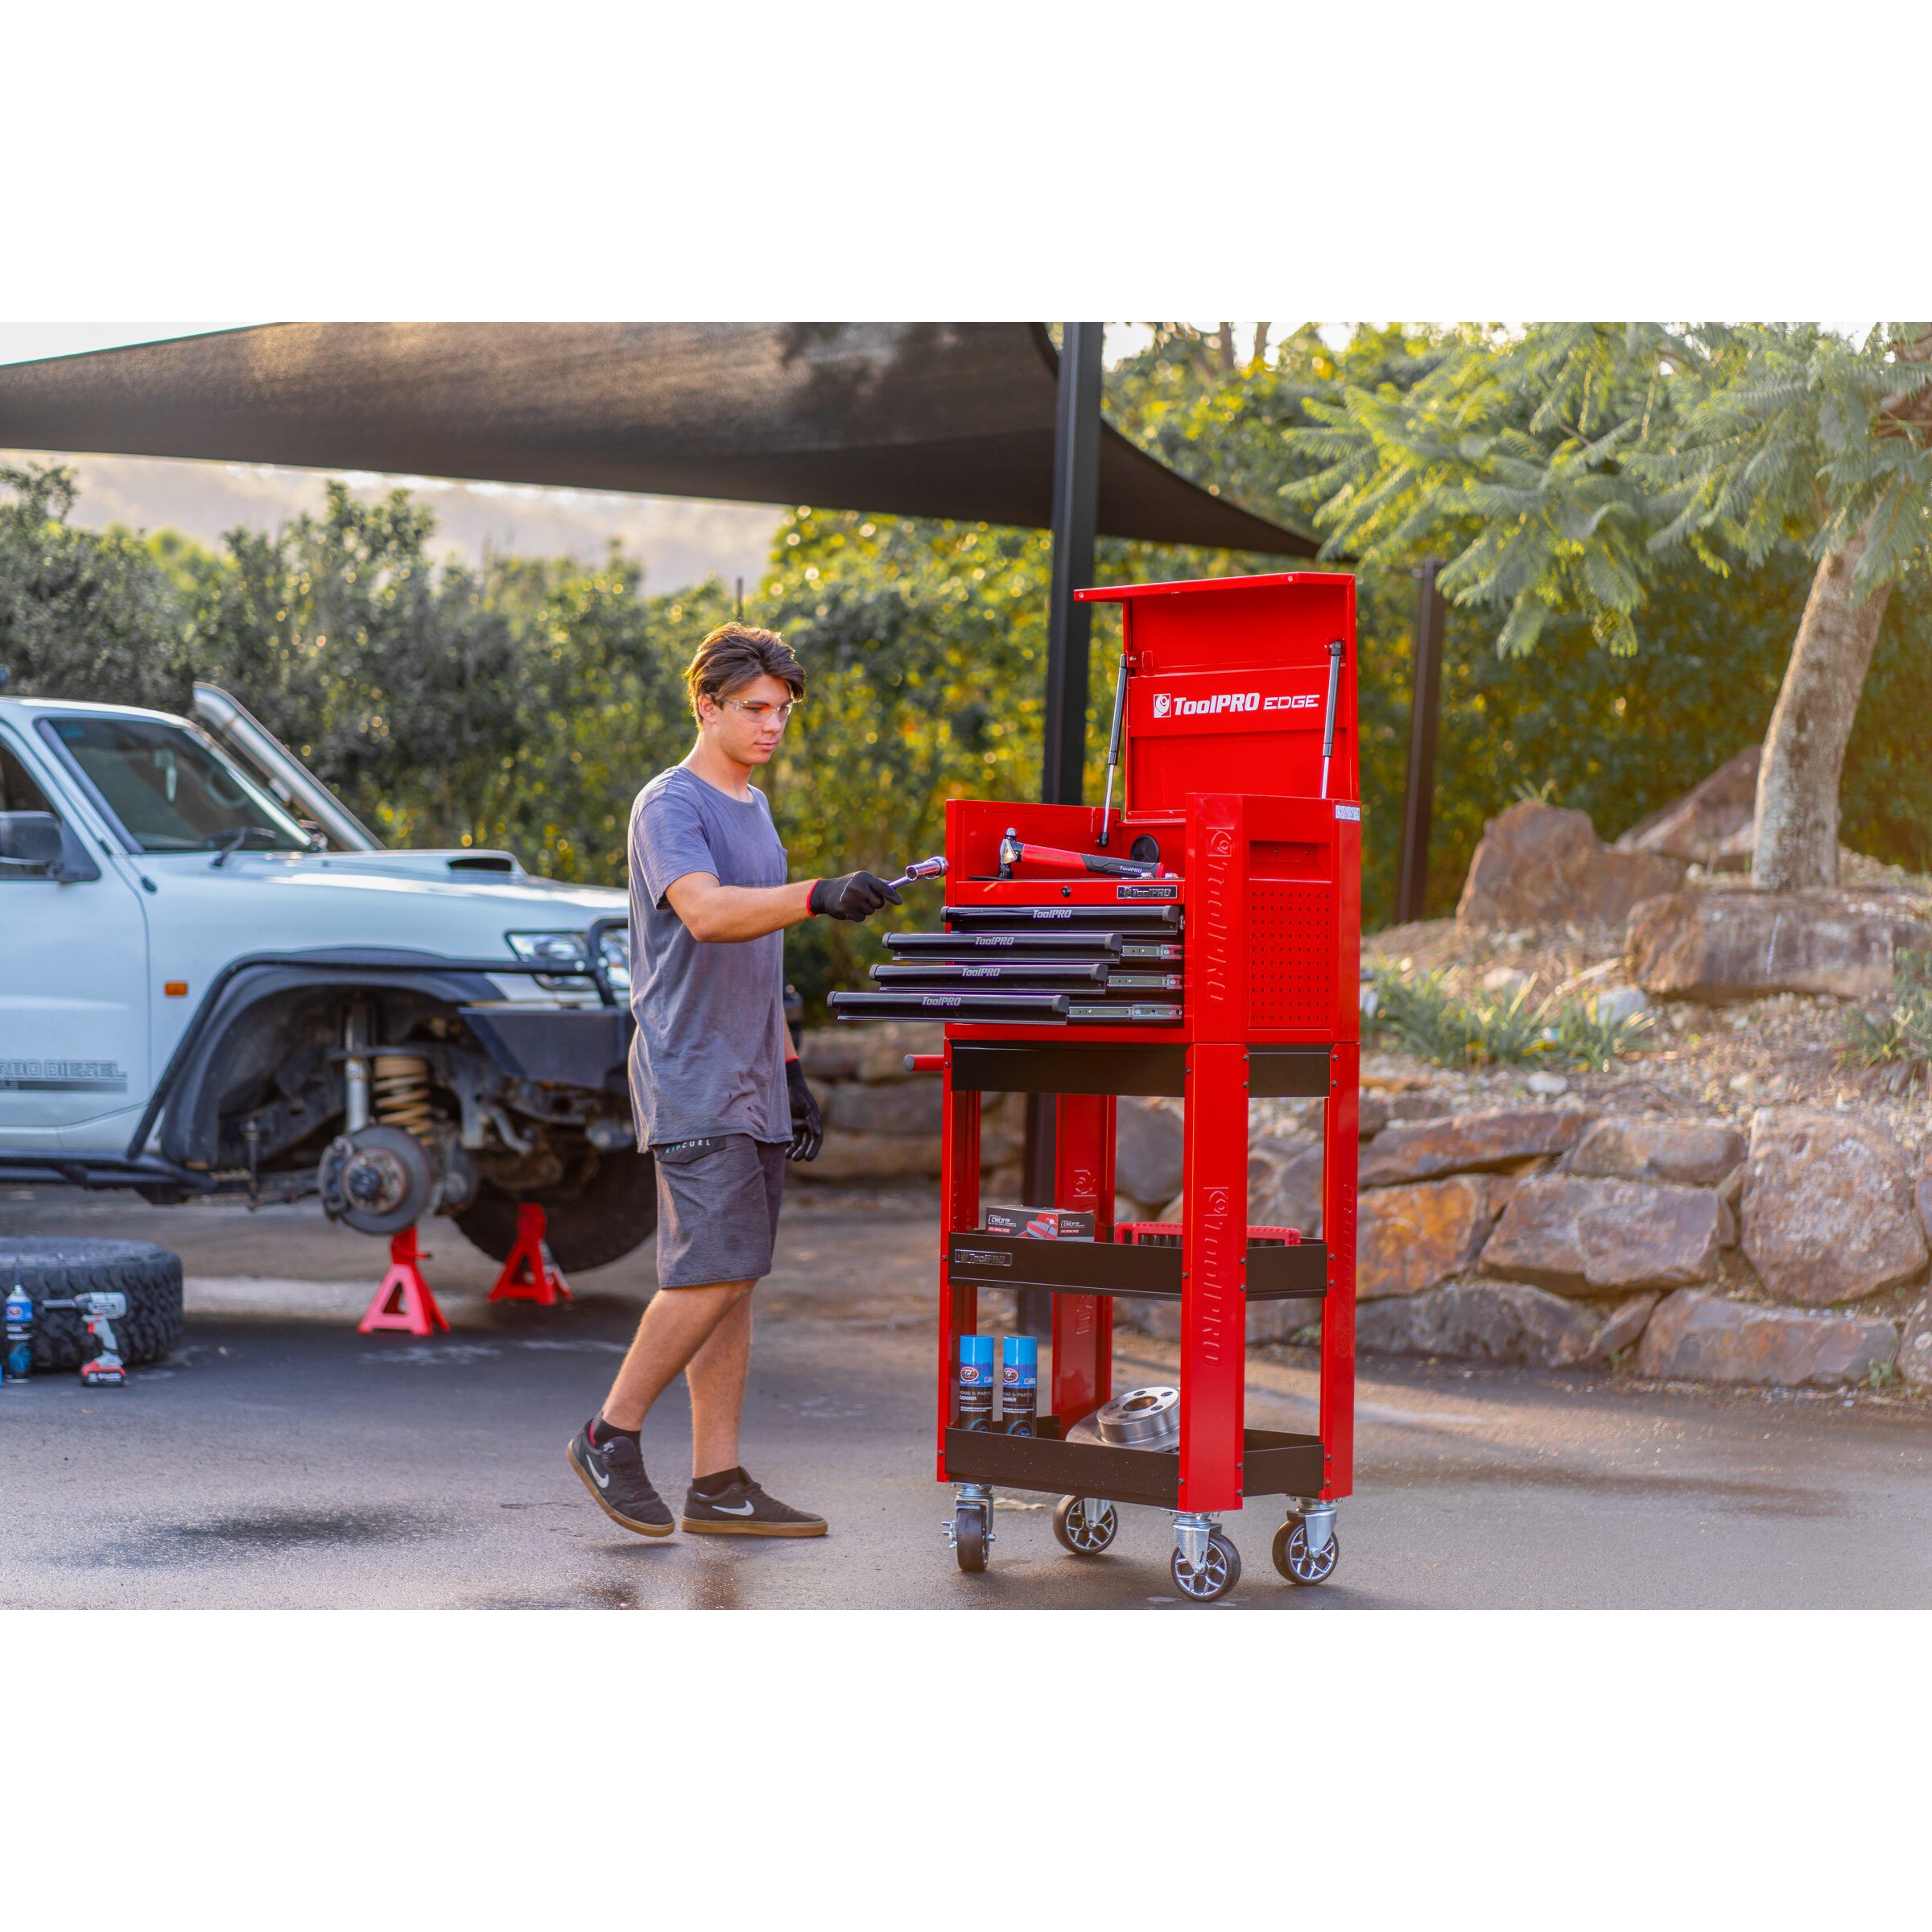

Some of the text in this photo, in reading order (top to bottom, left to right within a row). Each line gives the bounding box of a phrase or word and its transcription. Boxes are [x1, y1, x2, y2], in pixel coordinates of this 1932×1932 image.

[1174, 692, 1320, 715] ToolPRO EDGE
[1132, 888, 1170, 897] ToolPRO
[1033, 909, 1072, 919] ToolPRO
[976, 936, 1014, 945] ToolPRO
[962, 968, 1001, 976] ToolPRO
[922, 997, 961, 1006] ToolPRO
[43, 1059, 128, 1080] DIESEL
[682, 1139, 710, 1148] CURL
[969, 1253, 1005, 1264] ToolPRO
